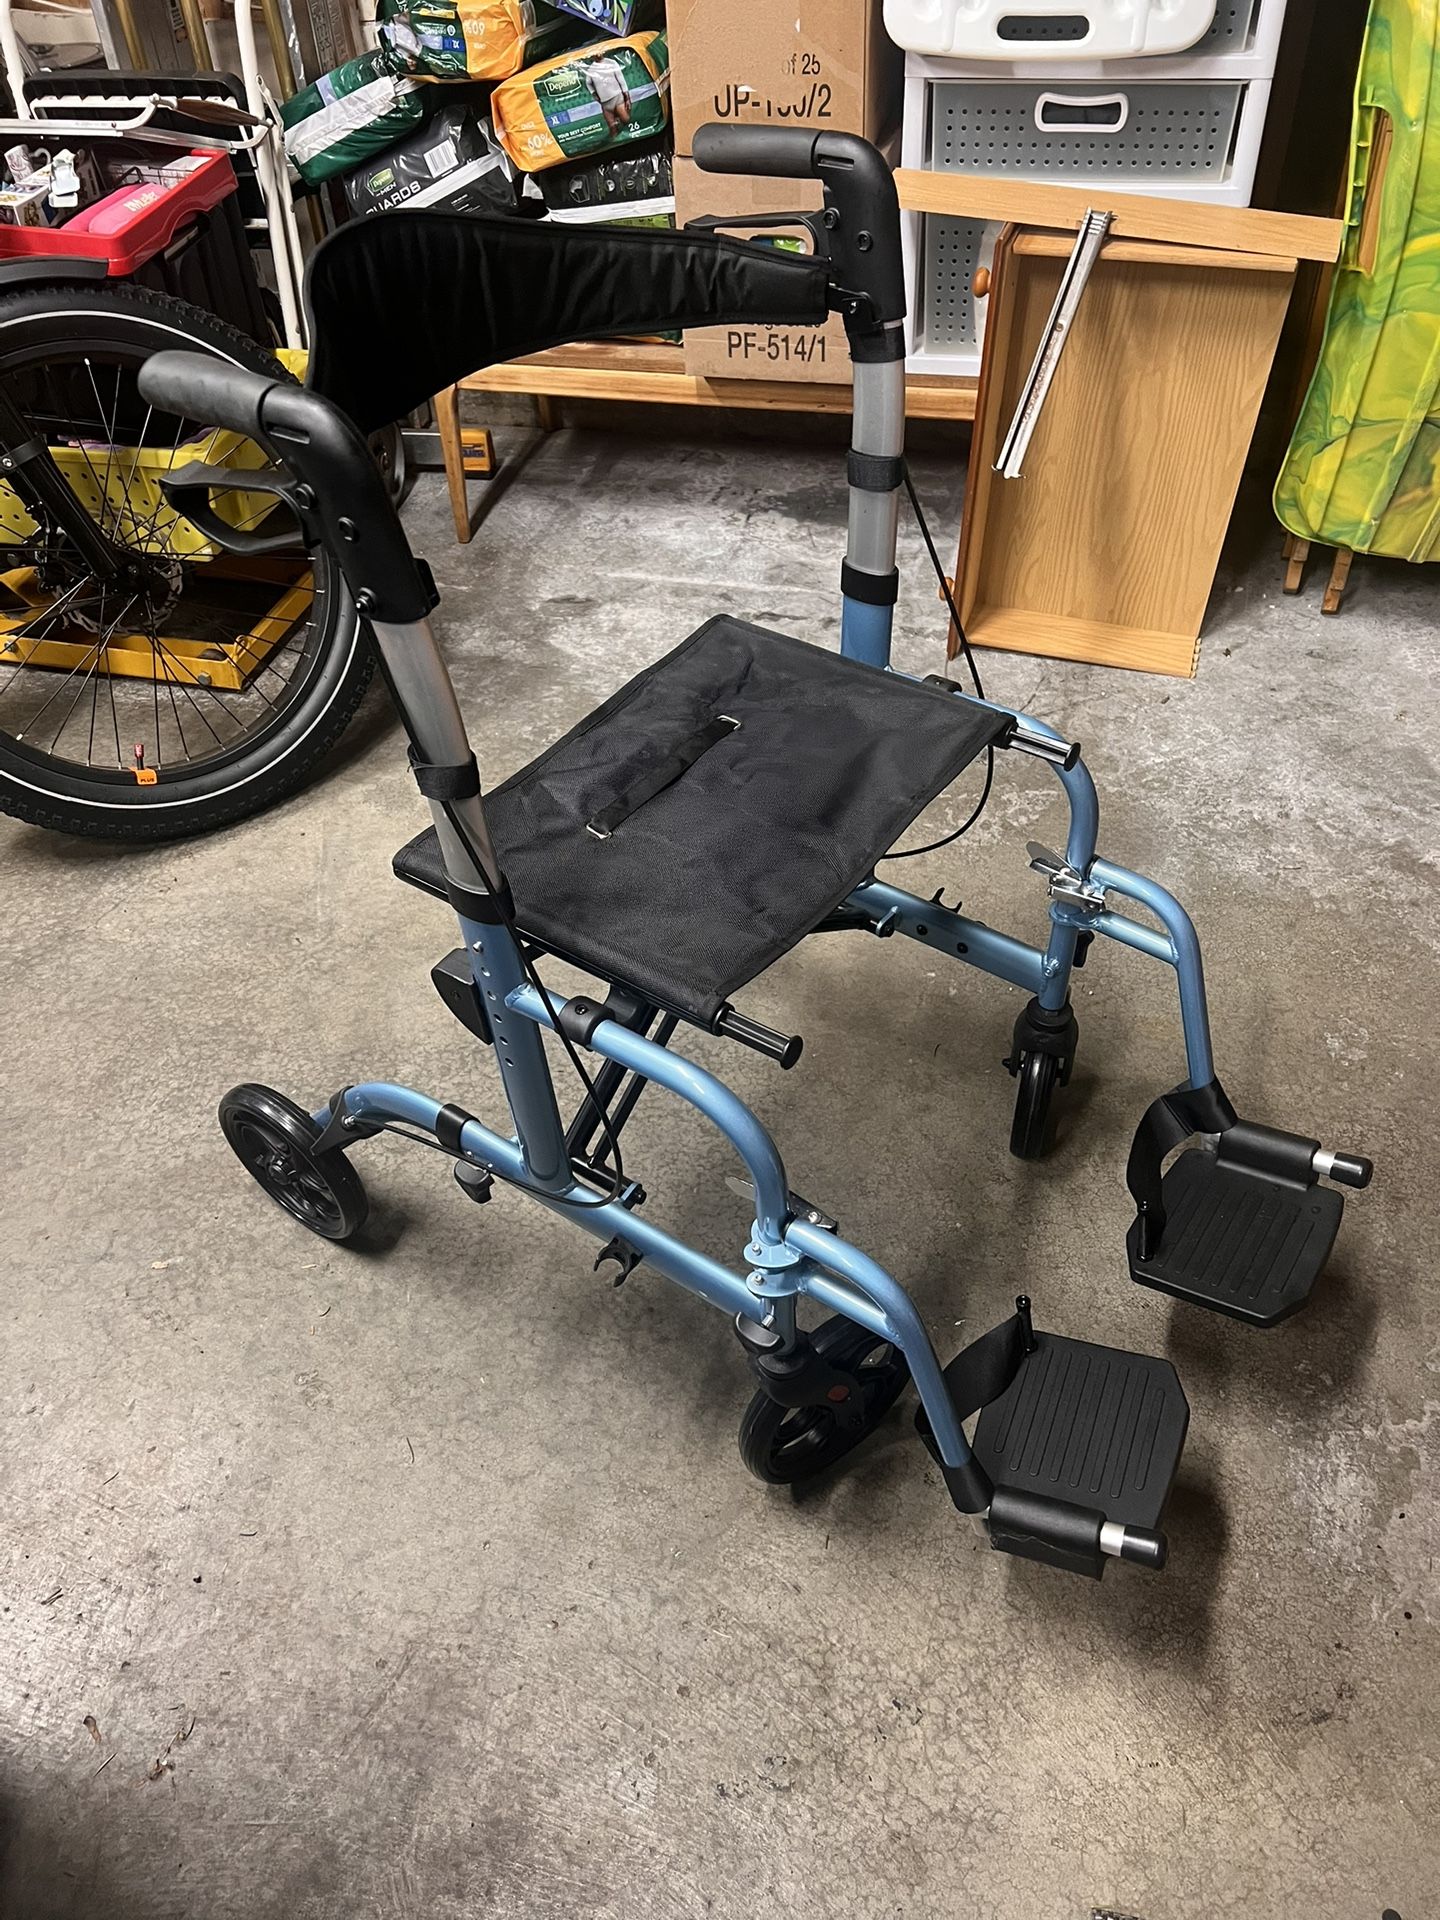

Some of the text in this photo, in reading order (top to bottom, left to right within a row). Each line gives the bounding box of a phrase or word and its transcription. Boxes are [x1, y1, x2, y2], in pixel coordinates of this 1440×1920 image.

[801, 53, 821, 75] 25
[548, 76, 578, 92] Depend
[550, 115, 561, 126] XL
[628, 121, 641, 132] 26
[527, 132, 554, 150] 60%
[380, 181, 397, 196] MEN
[365, 180, 422, 215] ARDS
[726, 331, 826, 363] PF-514/1
